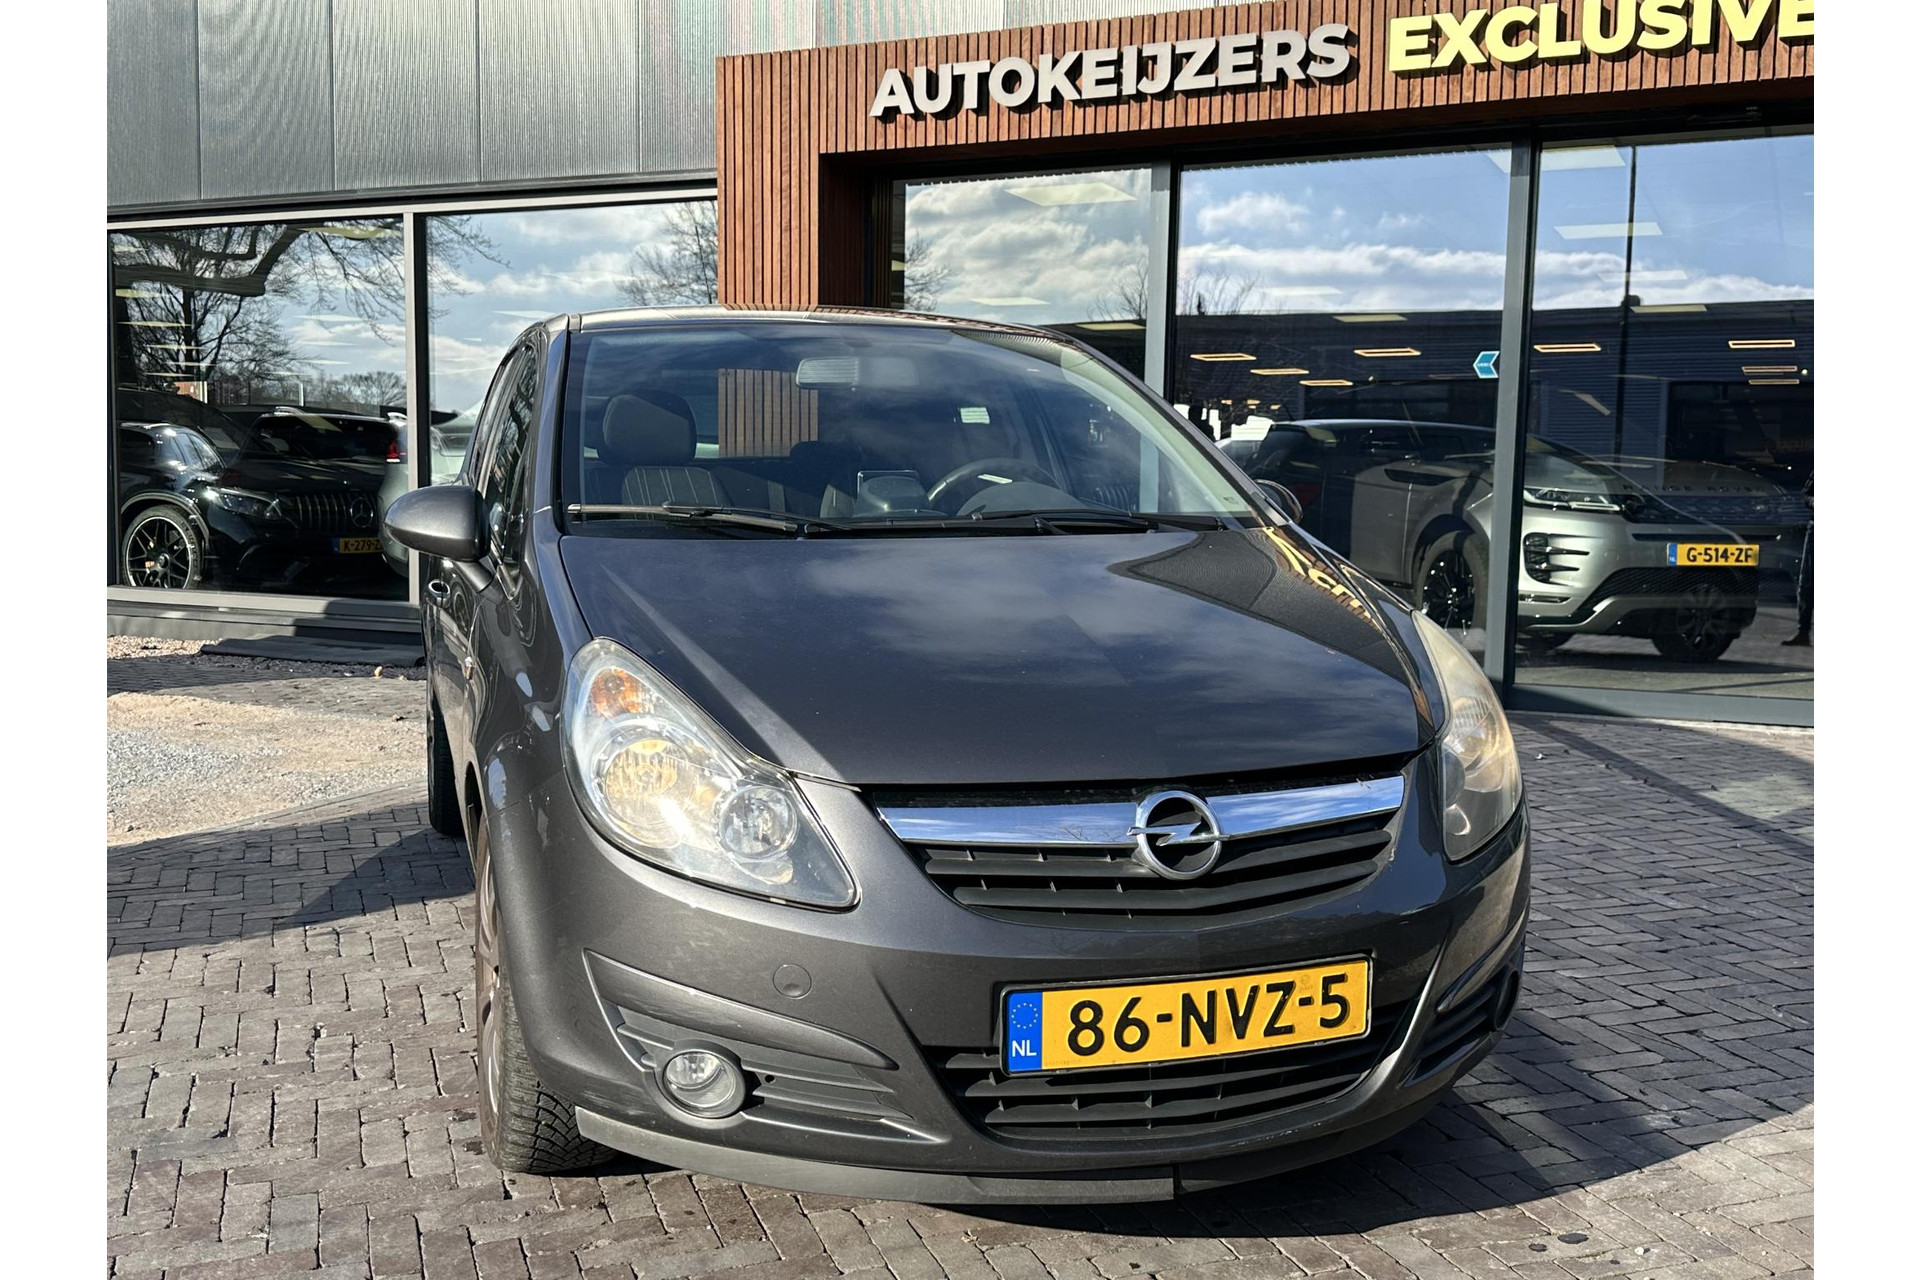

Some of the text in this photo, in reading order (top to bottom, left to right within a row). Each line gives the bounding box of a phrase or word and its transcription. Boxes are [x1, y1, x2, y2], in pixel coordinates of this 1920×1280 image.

[869, 23, 1351, 117] AUTOKEIJZERS
[343, 540, 381, 551] K-279-Z
[1686, 546, 1754, 563] G-514-ZF
[1067, 973, 1349, 1056] 86-NVZ-5
[1011, 1039, 1037, 1057] NL
